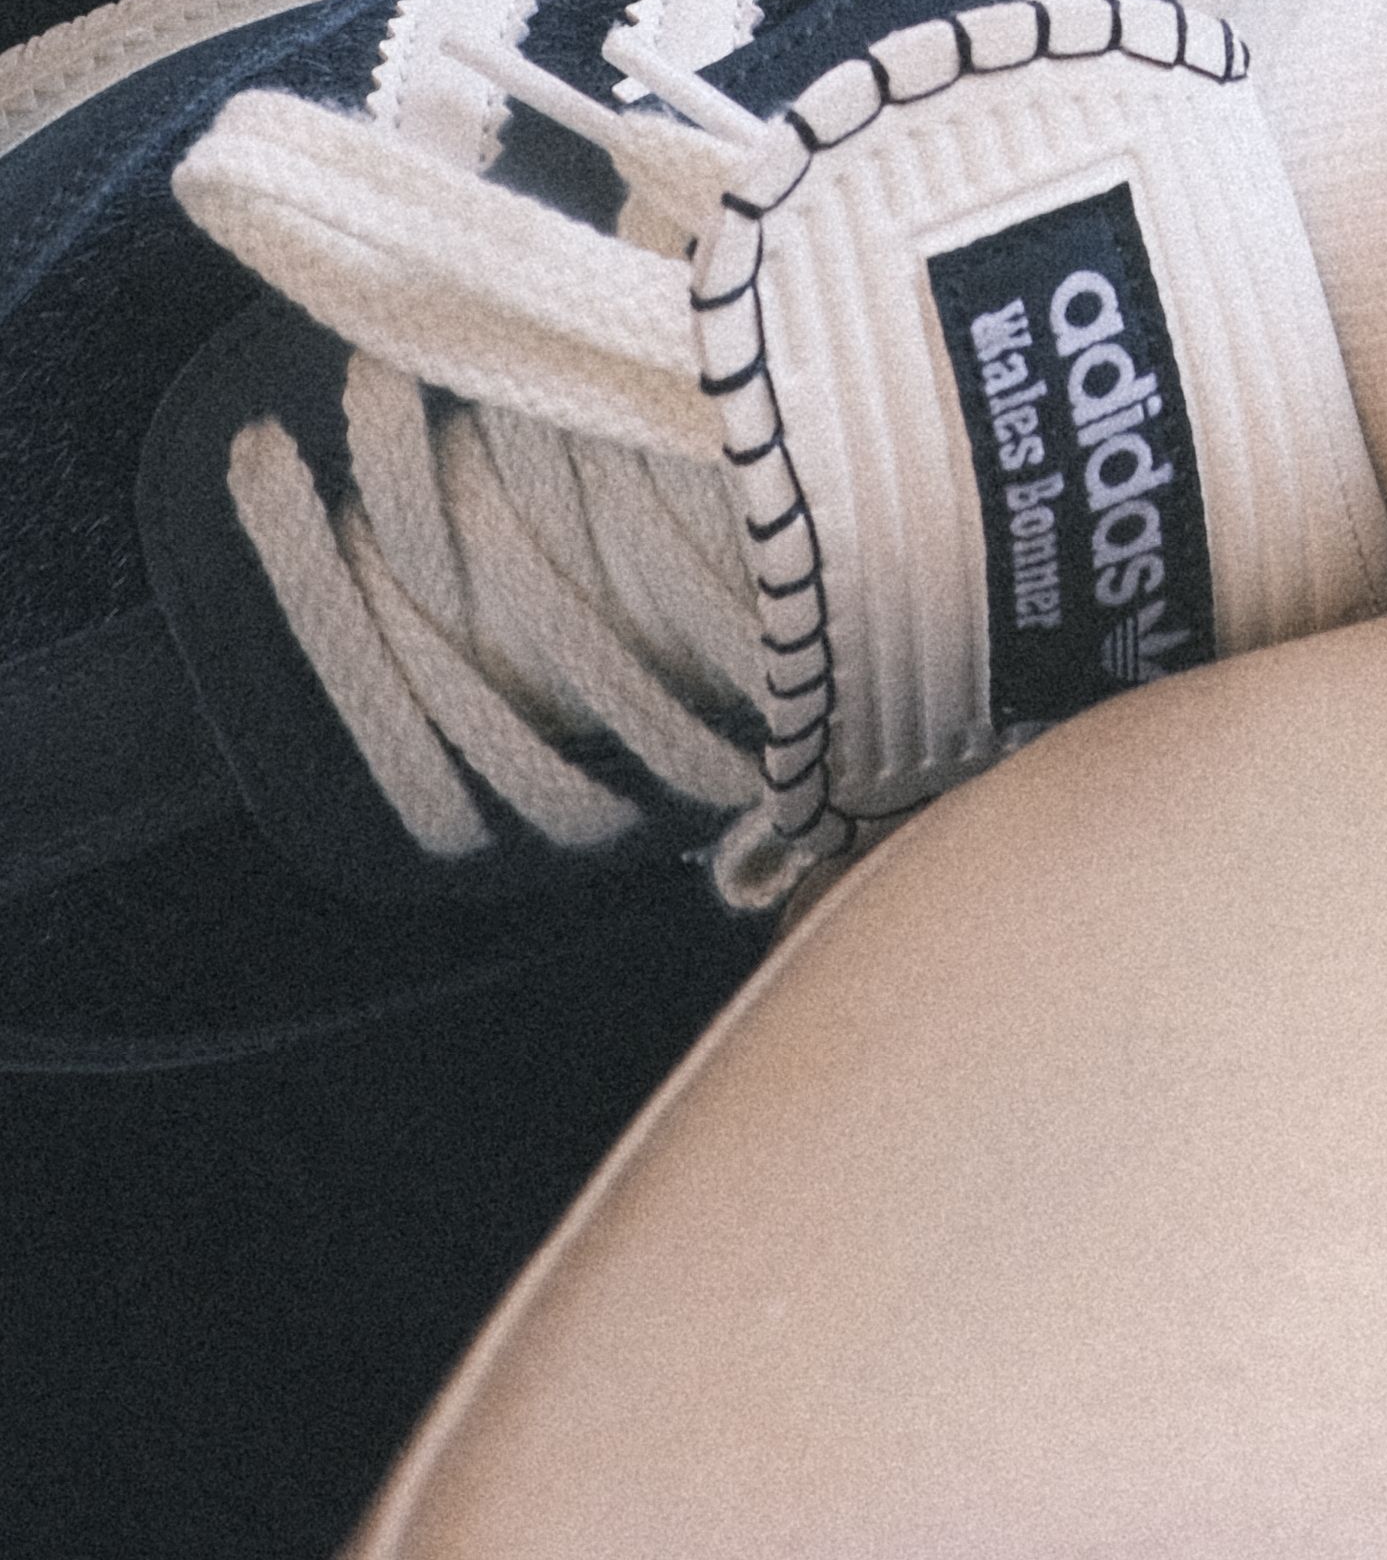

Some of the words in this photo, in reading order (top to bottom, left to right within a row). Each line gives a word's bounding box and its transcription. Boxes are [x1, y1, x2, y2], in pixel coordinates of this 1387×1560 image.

[970, 297, 1048, 471] Wales
[1049, 269, 1174, 606] adidas
[1005, 472, 1066, 629] Bonner
